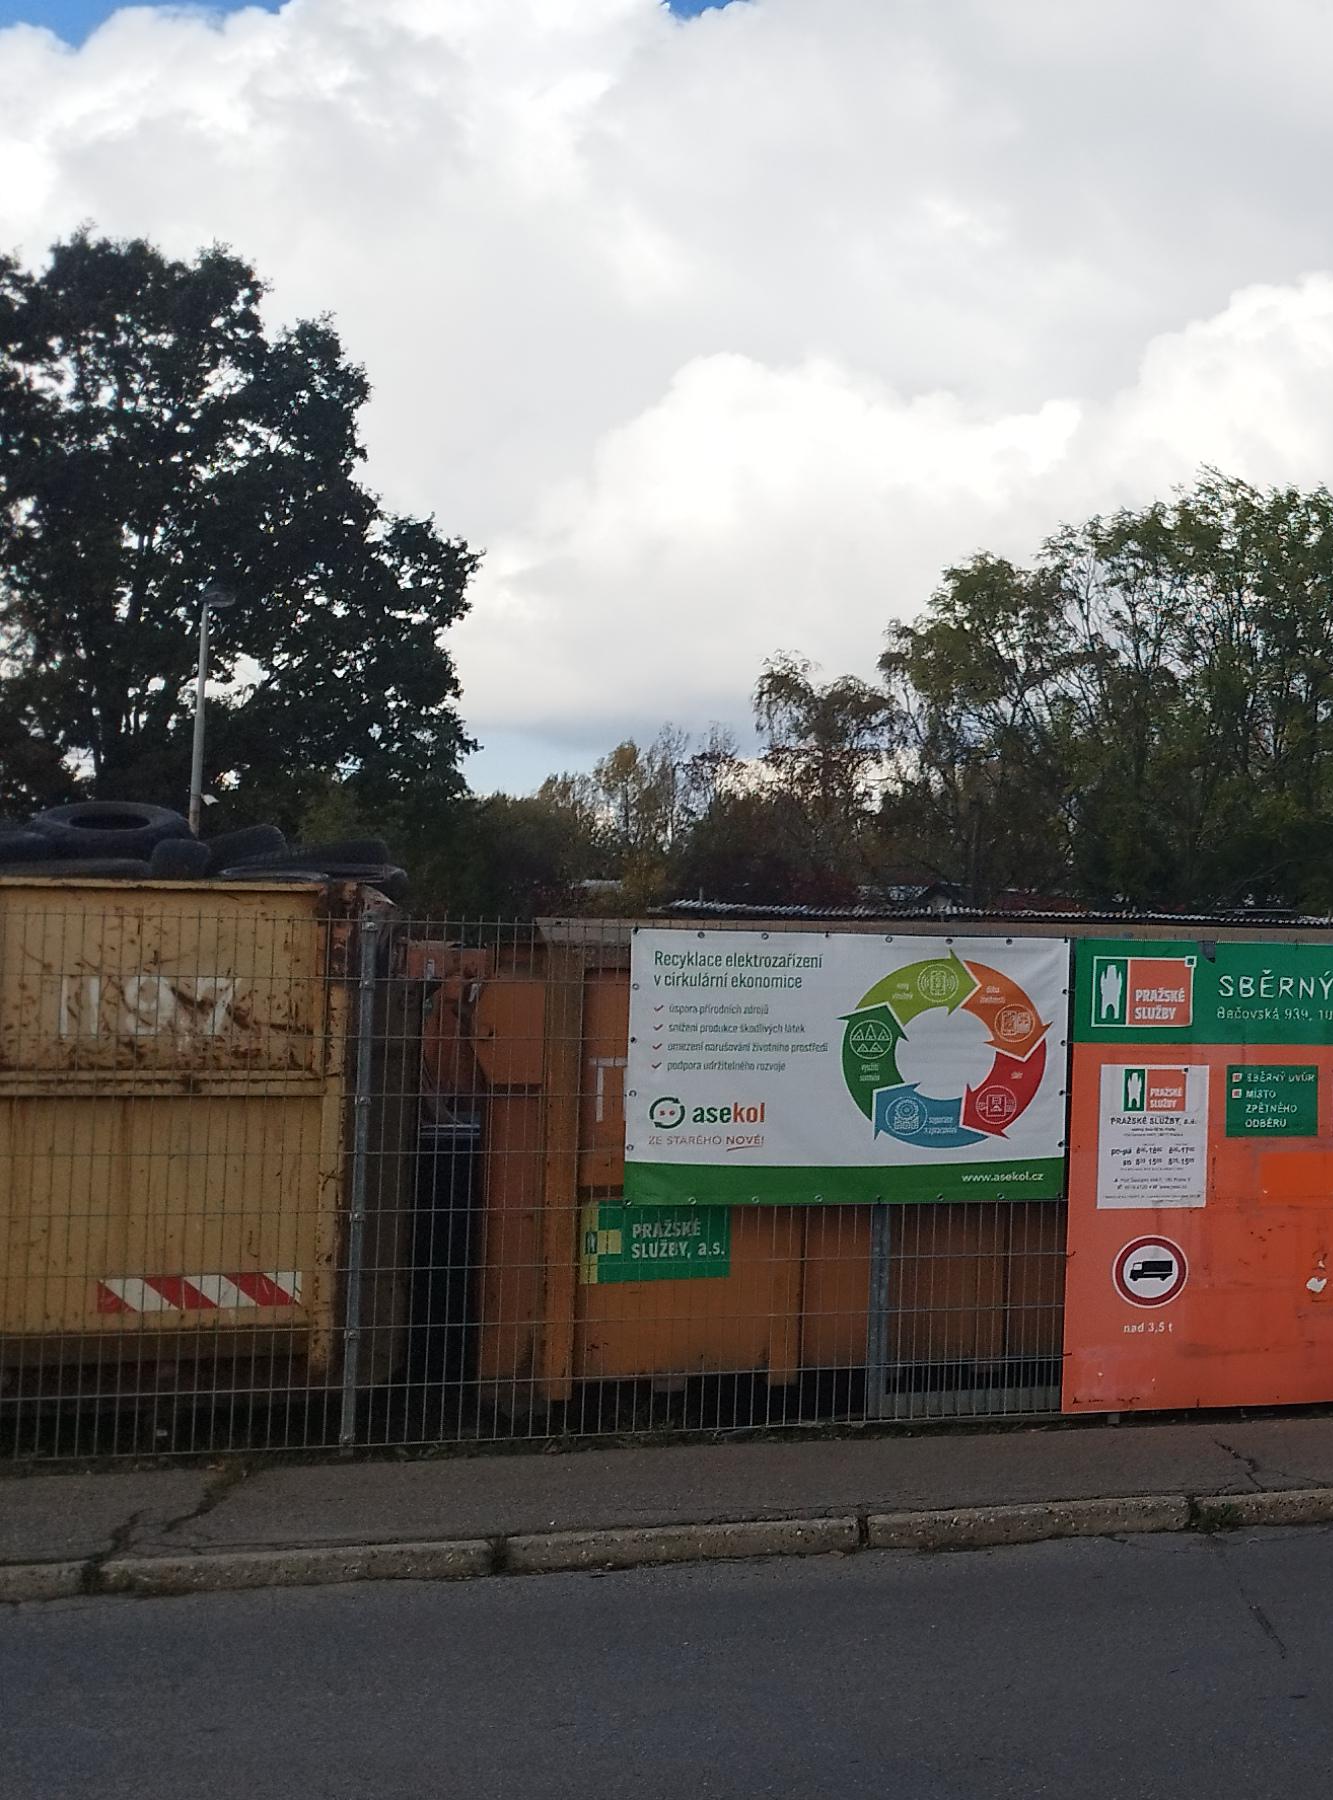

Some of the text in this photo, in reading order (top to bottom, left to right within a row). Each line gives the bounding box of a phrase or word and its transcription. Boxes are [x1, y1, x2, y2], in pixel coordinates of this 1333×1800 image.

[654, 951, 823, 969] Recyklace elektrozařízení
[654, 972, 803, 988] v cirkulární ekonomice
[1135, 987, 1185, 1002] PRAŽSKÉ
[1134, 1004, 1176, 1020] SLUŽBY
[1217, 1006, 1280, 1020] Bečovská
[700, 1024, 738, 1034] produkce
[1247, 1070, 1315, 1082] SBĚRNÝ DVŮR
[1246, 1088, 1276, 1099] MÍSTO
[692, 1102, 765, 1123] asekol
[1246, 1102, 1297, 1113] ZPĚTNÉHO
[1110, 1116, 1147, 1125] PRAŽSKÉ
[1149, 1116, 1180, 1125] SLUŽBY
[1245, 1117, 1287, 1128] ODBĚRU
[648, 1134, 764, 1145] ZE STARÉHO NOVÉ!
[961, 1171, 1044, 1182] www.asekol.cz
[632, 1218, 701, 1239] PRAŽSKÉ
[631, 1239, 725, 1259] SLUŽBY, a.s.
[1123, 1321, 1173, 1334] nad 3,5 t
